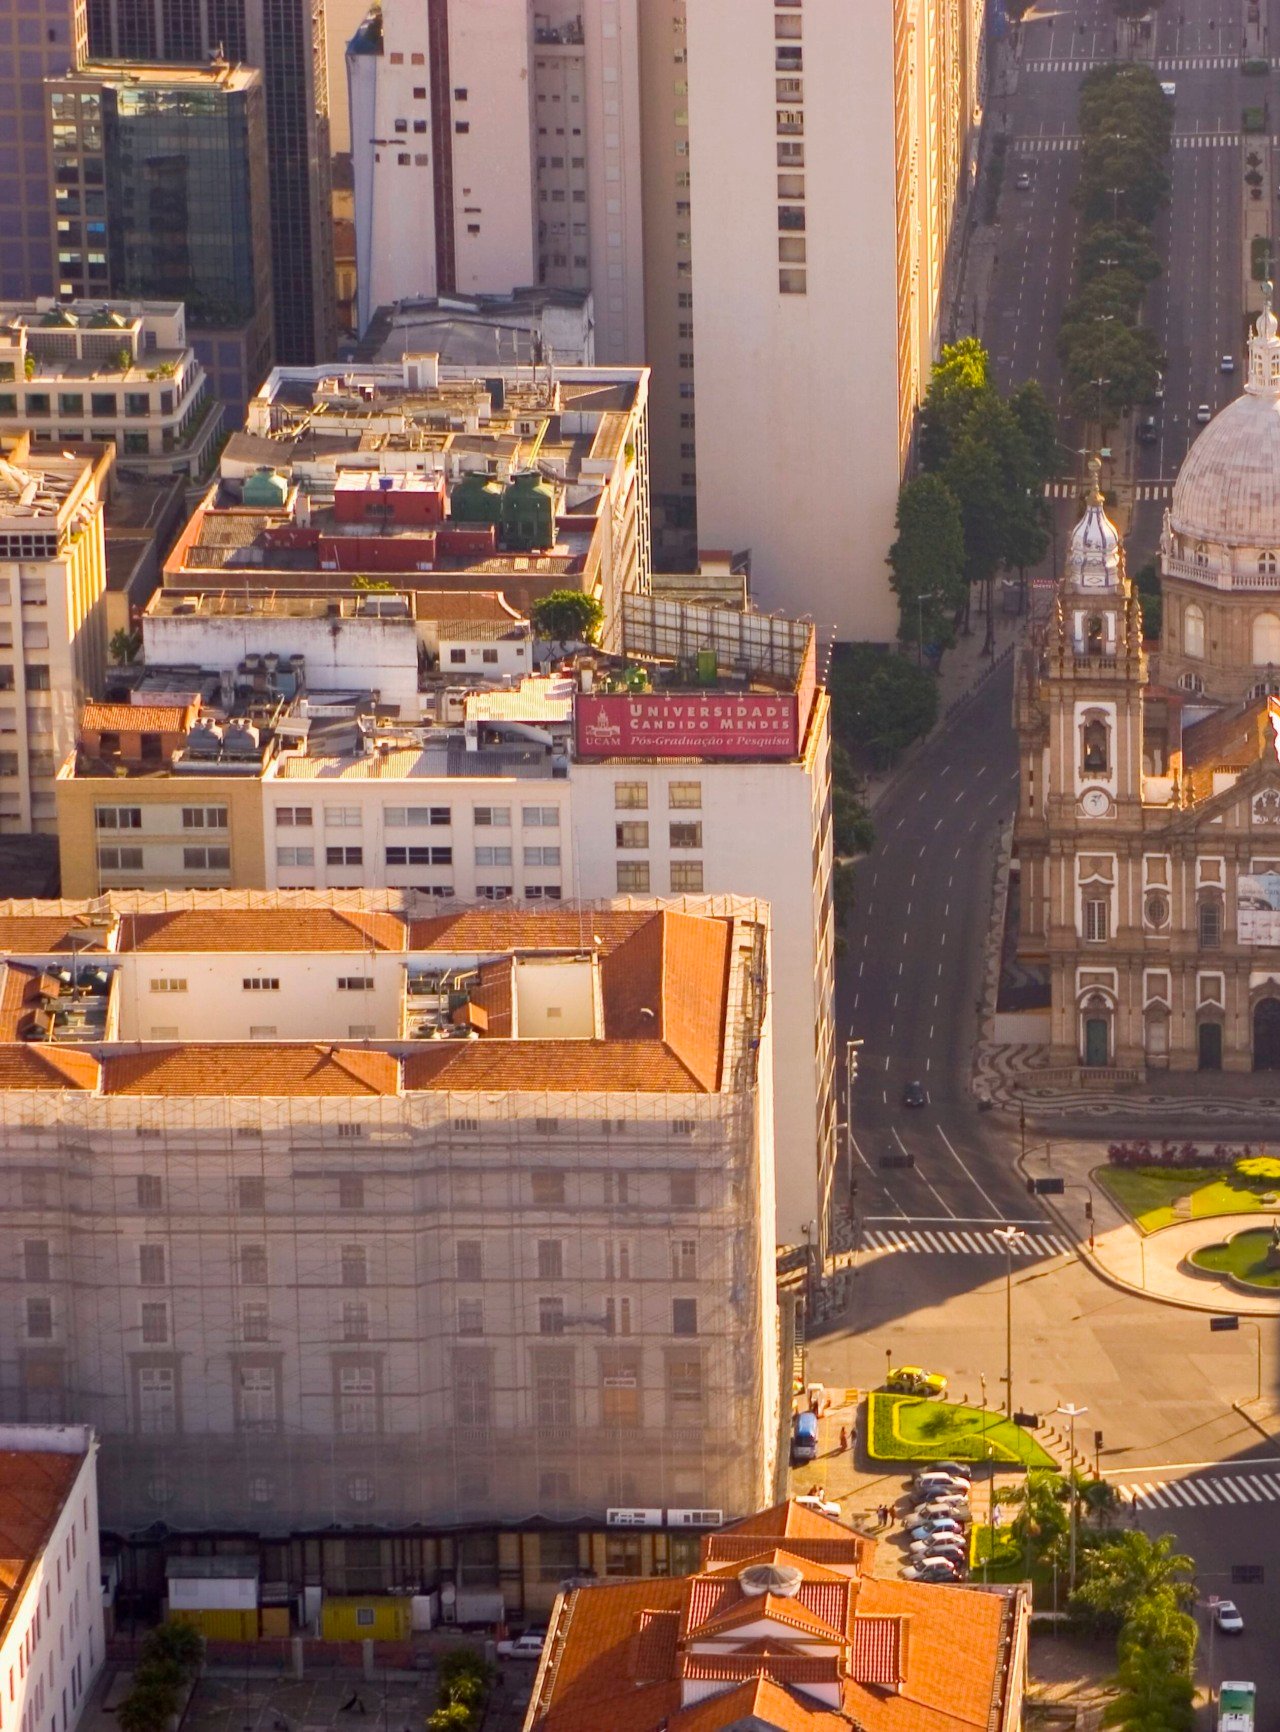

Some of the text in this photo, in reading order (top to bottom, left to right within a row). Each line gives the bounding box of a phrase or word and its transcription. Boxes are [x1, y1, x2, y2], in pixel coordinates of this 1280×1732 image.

[629, 704, 790, 717] UNIVERSIDADE
[629, 719, 790, 730] CANDIDO MENDES
[586, 738, 621, 746] UCAM
[630, 736, 722, 747] Pós-Graduação
[736, 736, 790, 747] Pesquisa
